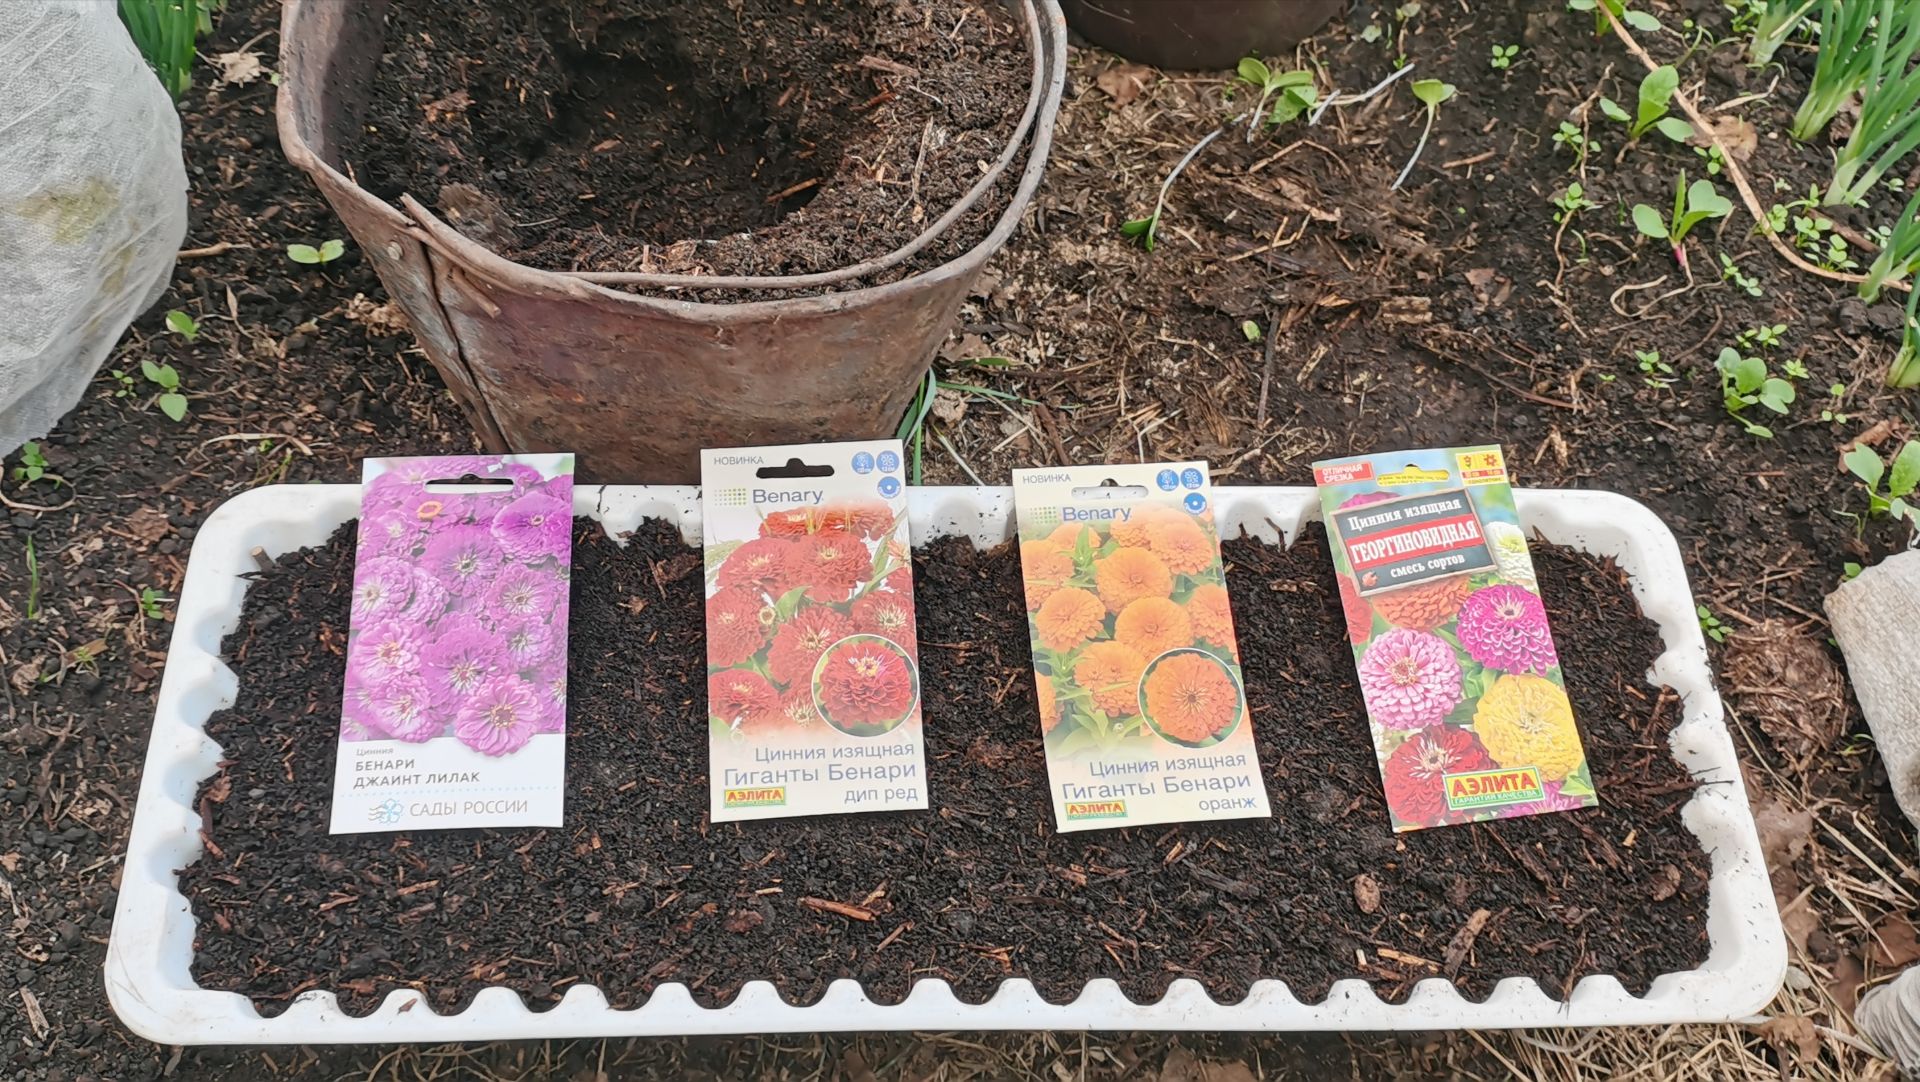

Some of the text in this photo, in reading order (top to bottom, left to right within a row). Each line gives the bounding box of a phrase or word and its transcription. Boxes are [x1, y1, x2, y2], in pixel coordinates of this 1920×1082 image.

[714, 456, 764, 465] НОВИНКА
[1322, 464, 1363, 475] ОТЛИЧНАЯ
[1022, 473, 1071, 484] НОВИНКА
[1325, 474, 1354, 483] СРЕЗКА
[752, 489, 824, 505] Benary
[1062, 506, 1132, 522] Benary
[1347, 498, 1463, 532] Цинния изящная
[1349, 520, 1480, 564] ГЕОРГИНОВИДНАЯ
[1390, 554, 1465, 578] смесь сортов
[356, 746, 394, 757] Цинния
[755, 743, 914, 762] Цинния изящная
[355, 758, 416, 772] БЕНАРИ
[1089, 754, 1247, 778] Цинния изящная
[353, 771, 481, 790] ДЖАИНТ ЛИЛАК
[724, 763, 916, 787] Гиганты Бенари
[1062, 774, 1251, 800] Гиганты Бенари
[1452, 773, 1537, 797] АЭЛИТА
[727, 789, 783, 802] АЭЛИТА
[844, 787, 918, 804] дип ред
[1199, 795, 1257, 813] оранж
[1455, 790, 1538, 805] ГАРАНТИЯ КАЧЕСТВА
[410, 799, 528, 817] САДЫ РОССИИ
[1069, 802, 1123, 815] АЭЛИТА
